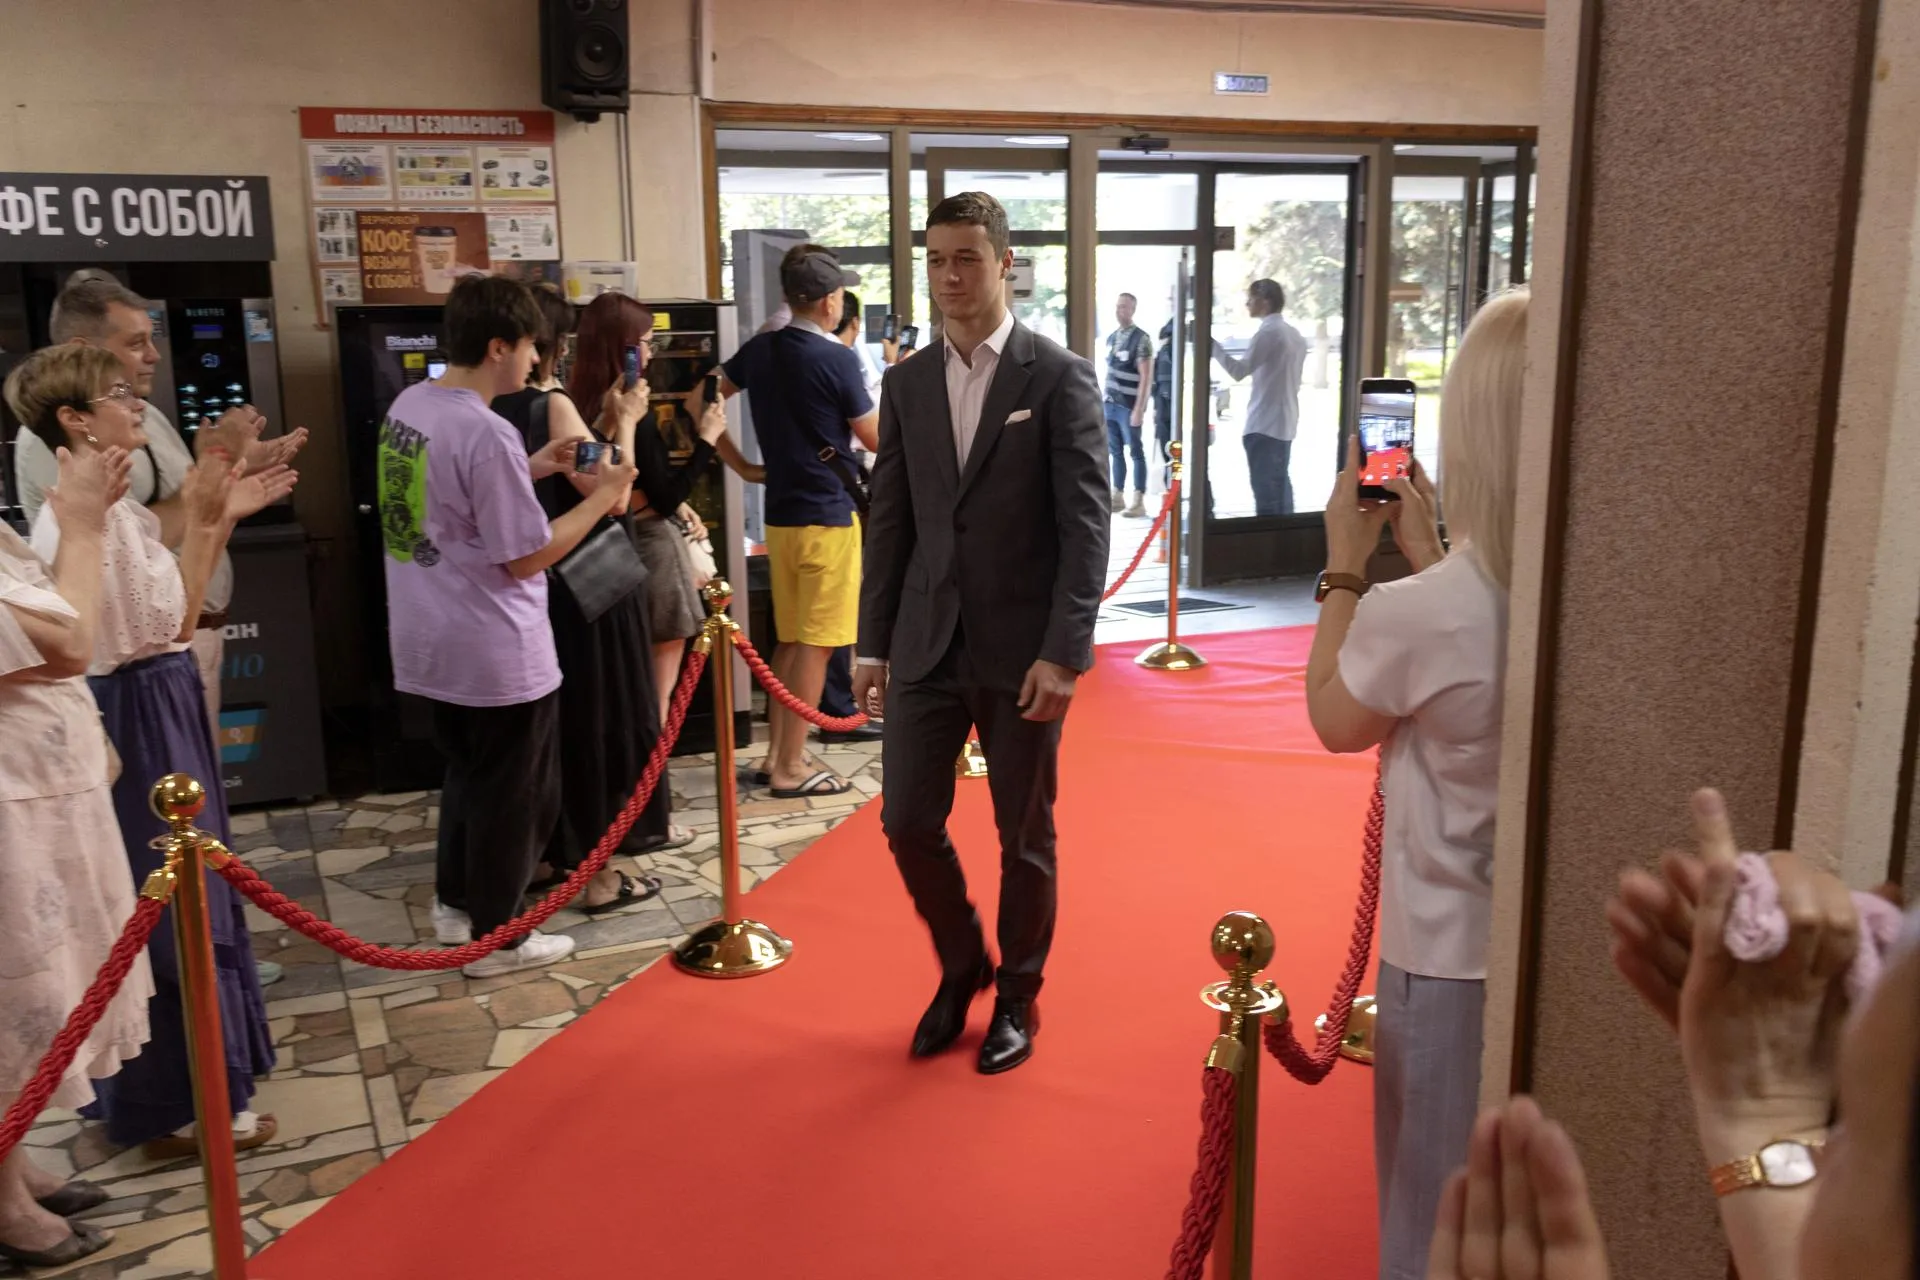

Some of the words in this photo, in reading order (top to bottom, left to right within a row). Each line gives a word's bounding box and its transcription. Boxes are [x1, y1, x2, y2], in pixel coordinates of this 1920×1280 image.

[334, 114, 415, 134] ПОЖАРНАЯ
[416, 116, 525, 135] БЕЗОПАСНОСТЬ
[72, 187, 102, 236] С
[111, 180, 253, 237] СОБОЙ
[360, 214, 420, 225] ЗЕРНОВОЙ
[361, 229, 412, 253] КОФЕ
[363, 255, 411, 270] ВОЗЬМИ
[365, 274, 373, 289] С
[385, 335, 437, 346] Bianchi
